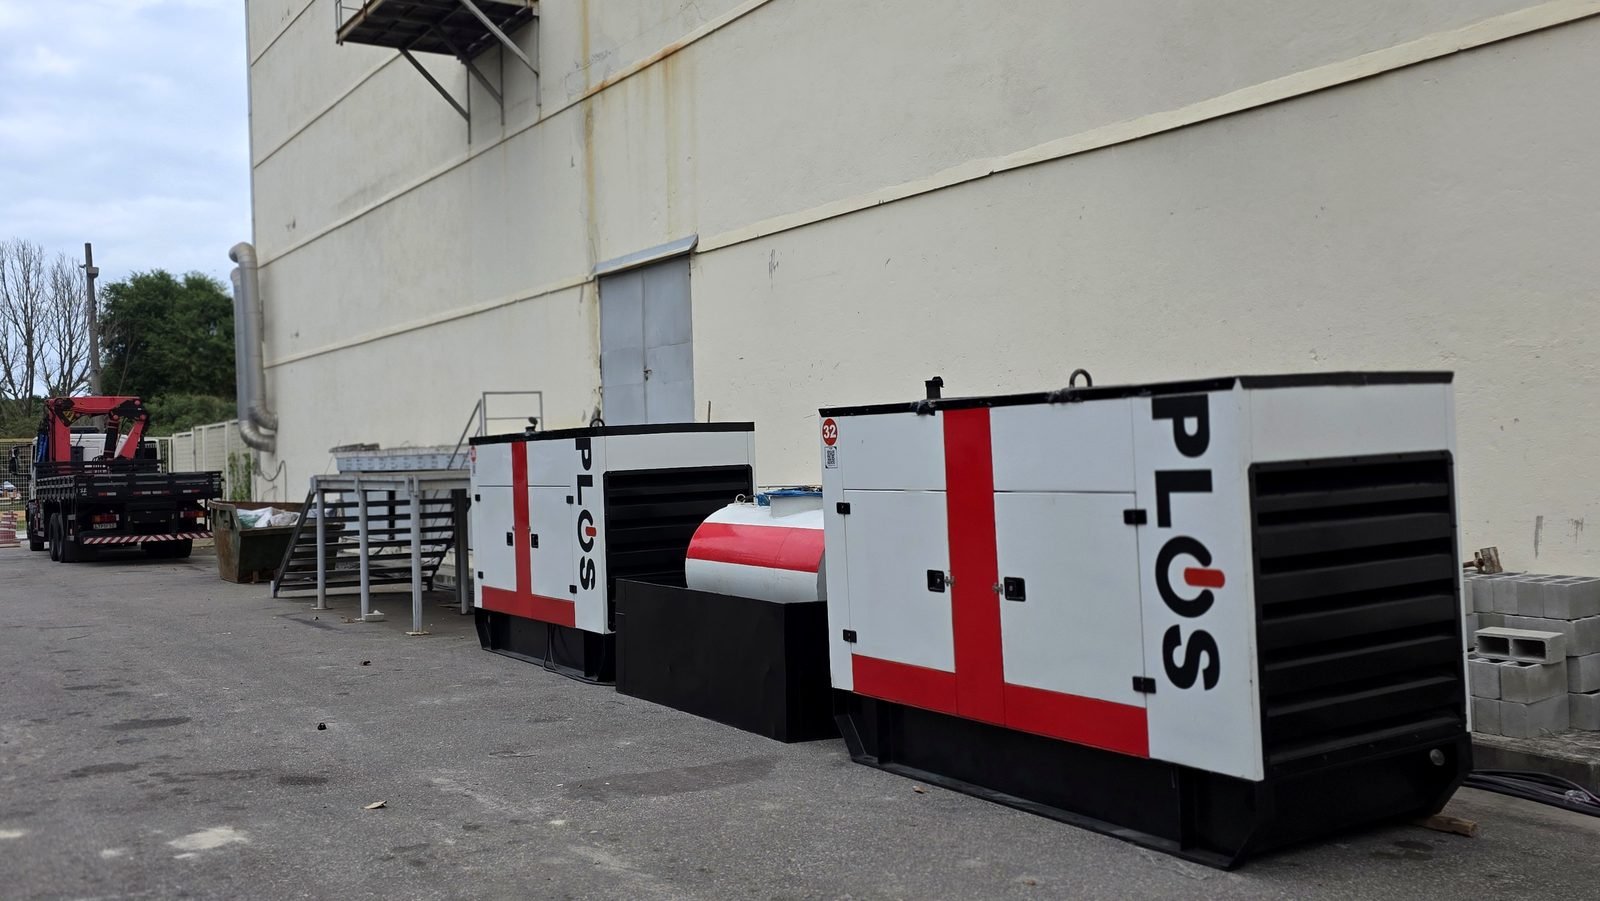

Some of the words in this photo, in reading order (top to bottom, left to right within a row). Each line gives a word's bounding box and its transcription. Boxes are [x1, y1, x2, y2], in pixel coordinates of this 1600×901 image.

[823, 424, 836, 439] 32
[575, 437, 597, 590] PLOS
[1152, 394, 1225, 691] PLOS
